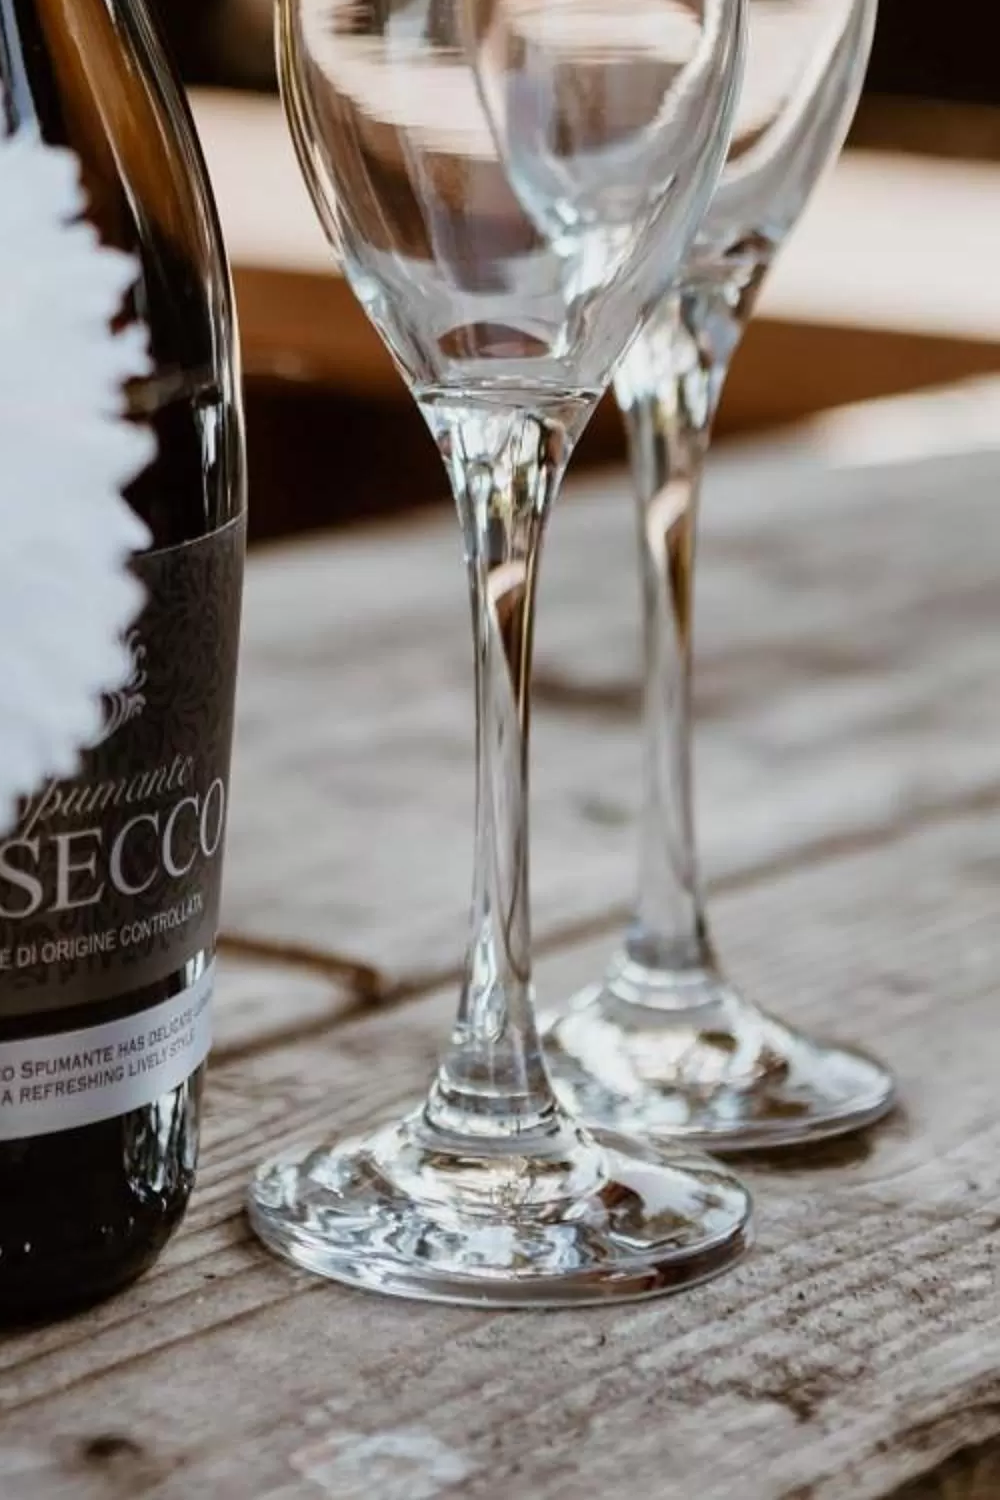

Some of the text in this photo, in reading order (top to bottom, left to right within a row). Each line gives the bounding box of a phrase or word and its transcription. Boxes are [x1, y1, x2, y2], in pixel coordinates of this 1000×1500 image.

[20, 752, 193, 840] pumante
[17, 944, 37, 968] DI
[40, 928, 117, 964] ORIGINE
[1, 1089, 14, 1108] A
[19, 1066, 126, 1103] REFRESHING
[128, 1049, 168, 1077] LIVELY
[20, 1044, 115, 1080] SPUMANTE
[118, 1035, 146, 1060] HAS
